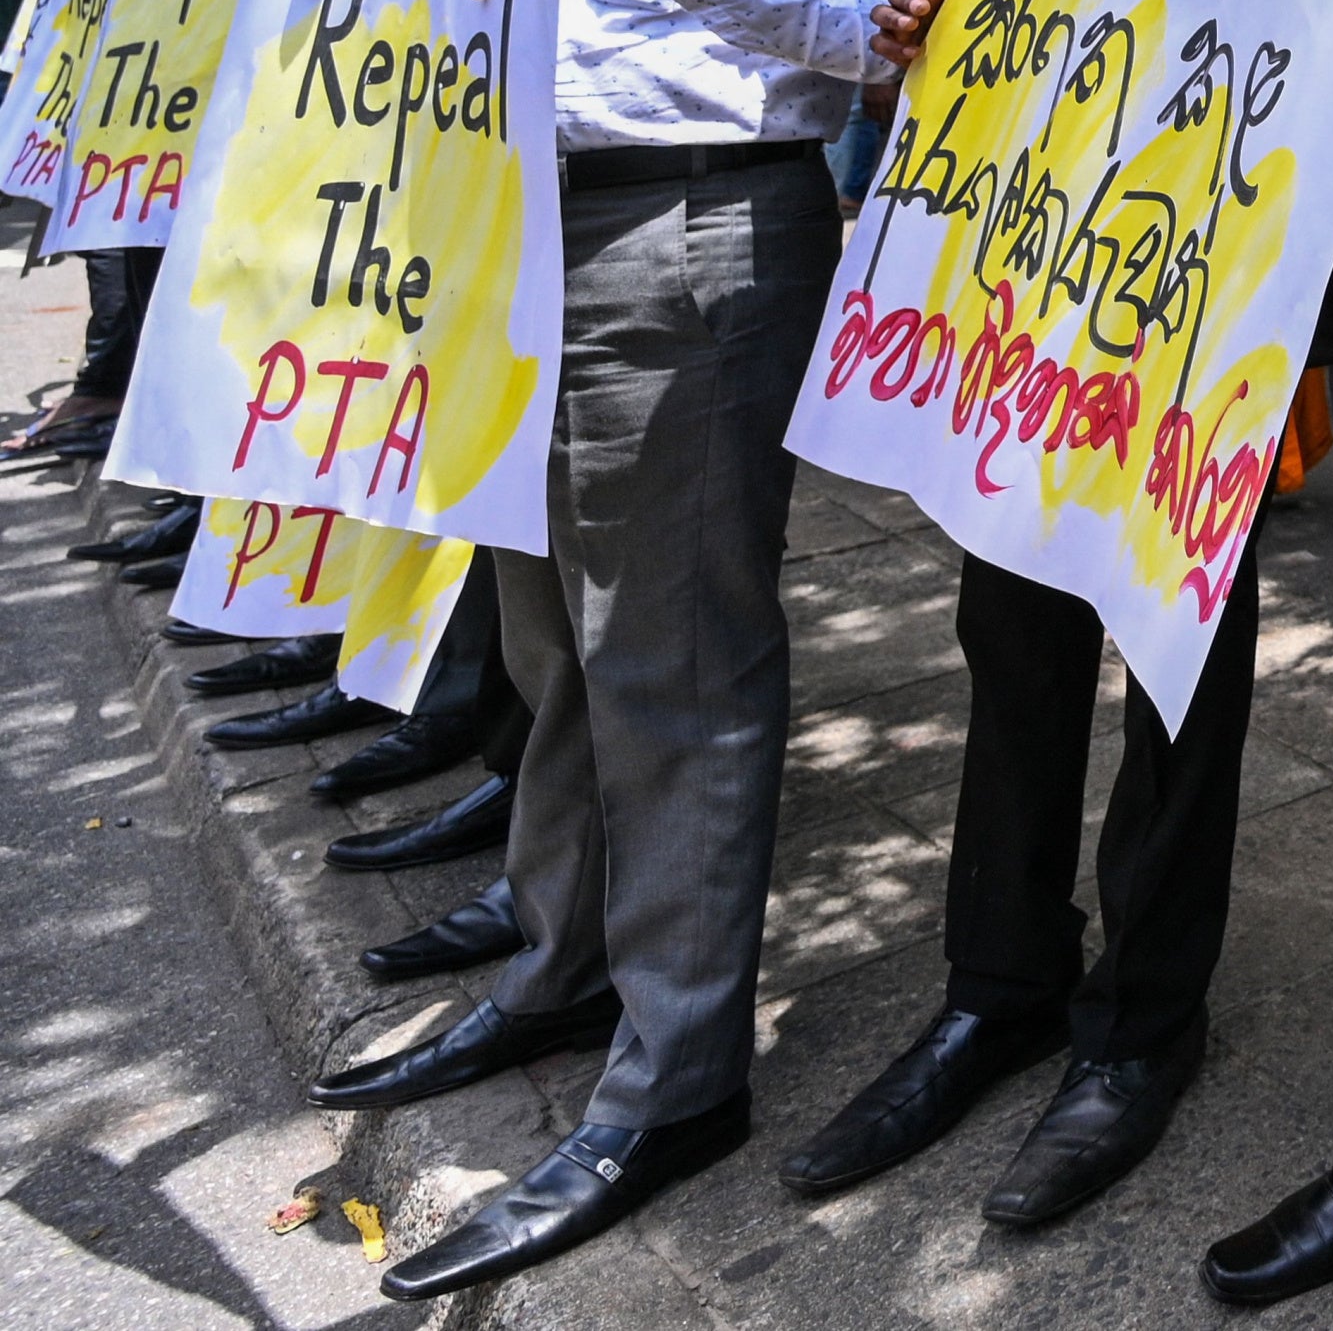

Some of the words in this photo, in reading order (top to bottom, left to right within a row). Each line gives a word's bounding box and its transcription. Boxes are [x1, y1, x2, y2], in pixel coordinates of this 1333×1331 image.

[99, 40, 199, 133] The
[5, 130, 63, 187] PTA
[68, 150, 184, 228] PTA
[311, 181, 431, 334] The
[231, 340, 430, 499] PTA
[223, 501, 346, 610] PT
